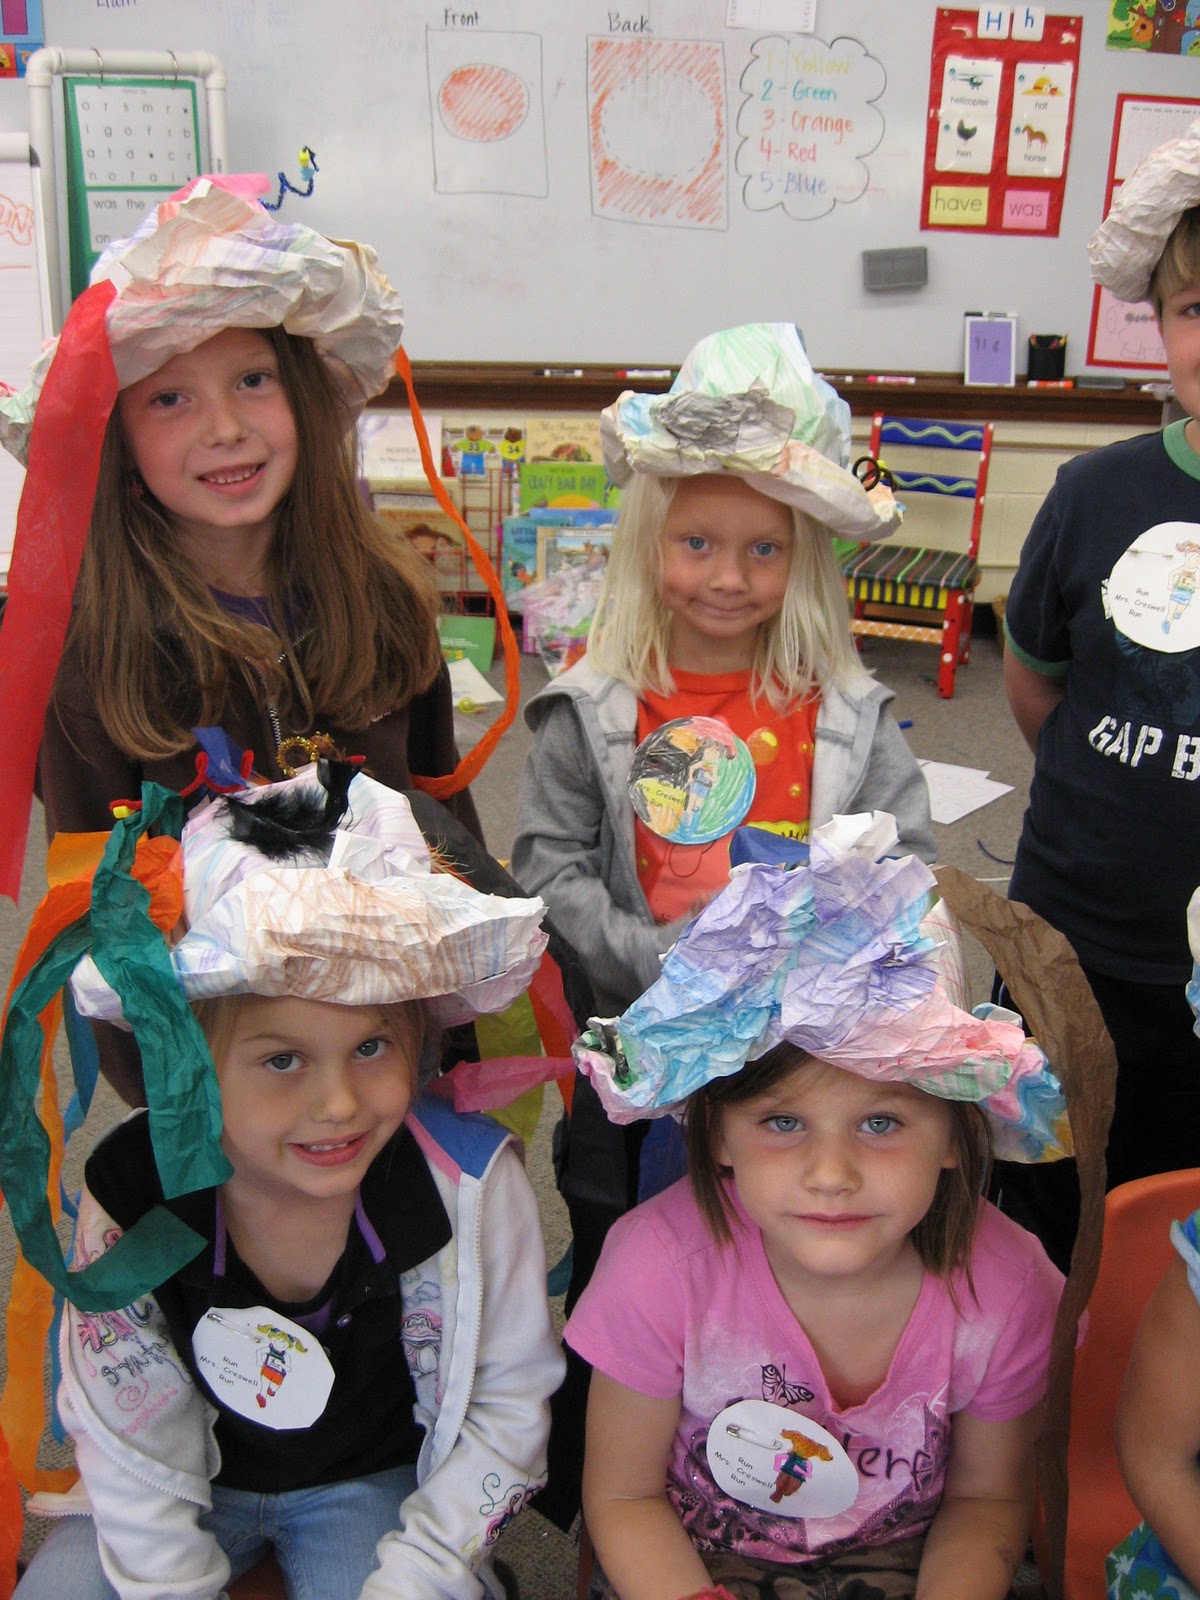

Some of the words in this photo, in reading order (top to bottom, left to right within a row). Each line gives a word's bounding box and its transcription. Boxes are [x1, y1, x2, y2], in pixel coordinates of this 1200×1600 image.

[444, 9, 480, 27] Front
[607, 11, 654, 33] Back
[986, 11, 1002, 31] H
[1024, 8, 1034, 28] h
[792, 79, 838, 101] Green
[142, 103, 153, 113] m
[950, 96, 989, 108] helicopter
[104, 126, 112, 138] g
[183, 128, 192, 139] b
[791, 110, 854, 145] Orange
[126, 149, 135, 160] d
[167, 152, 176, 161] c
[788, 141, 817, 163] Red
[956, 149, 972, 158] hen
[1024, 153, 1047, 163] horse
[94, 199, 118, 210] was
[126, 198, 146, 210] the
[935, 189, 982, 212] have
[1009, 201, 1043, 217] was
[95, 234, 111, 244] on
[468, 442, 480, 452] 33
[508, 445, 520, 454] 34
[1136, 587, 1150, 597] Run
[1134, 599, 1166, 613] Creswell
[1128, 608, 1142, 618] Run
[1088, 715, 1163, 768] GAP
[650, 798, 664, 808] Run
[222, 1356, 239, 1369] Run
[218, 1373, 235, 1386] Run
[223, 1366, 259, 1387] Creswell
[738, 1456, 753, 1470] Run
[730, 1473, 746, 1486] Run
[736, 1467, 774, 1489] Creswell
